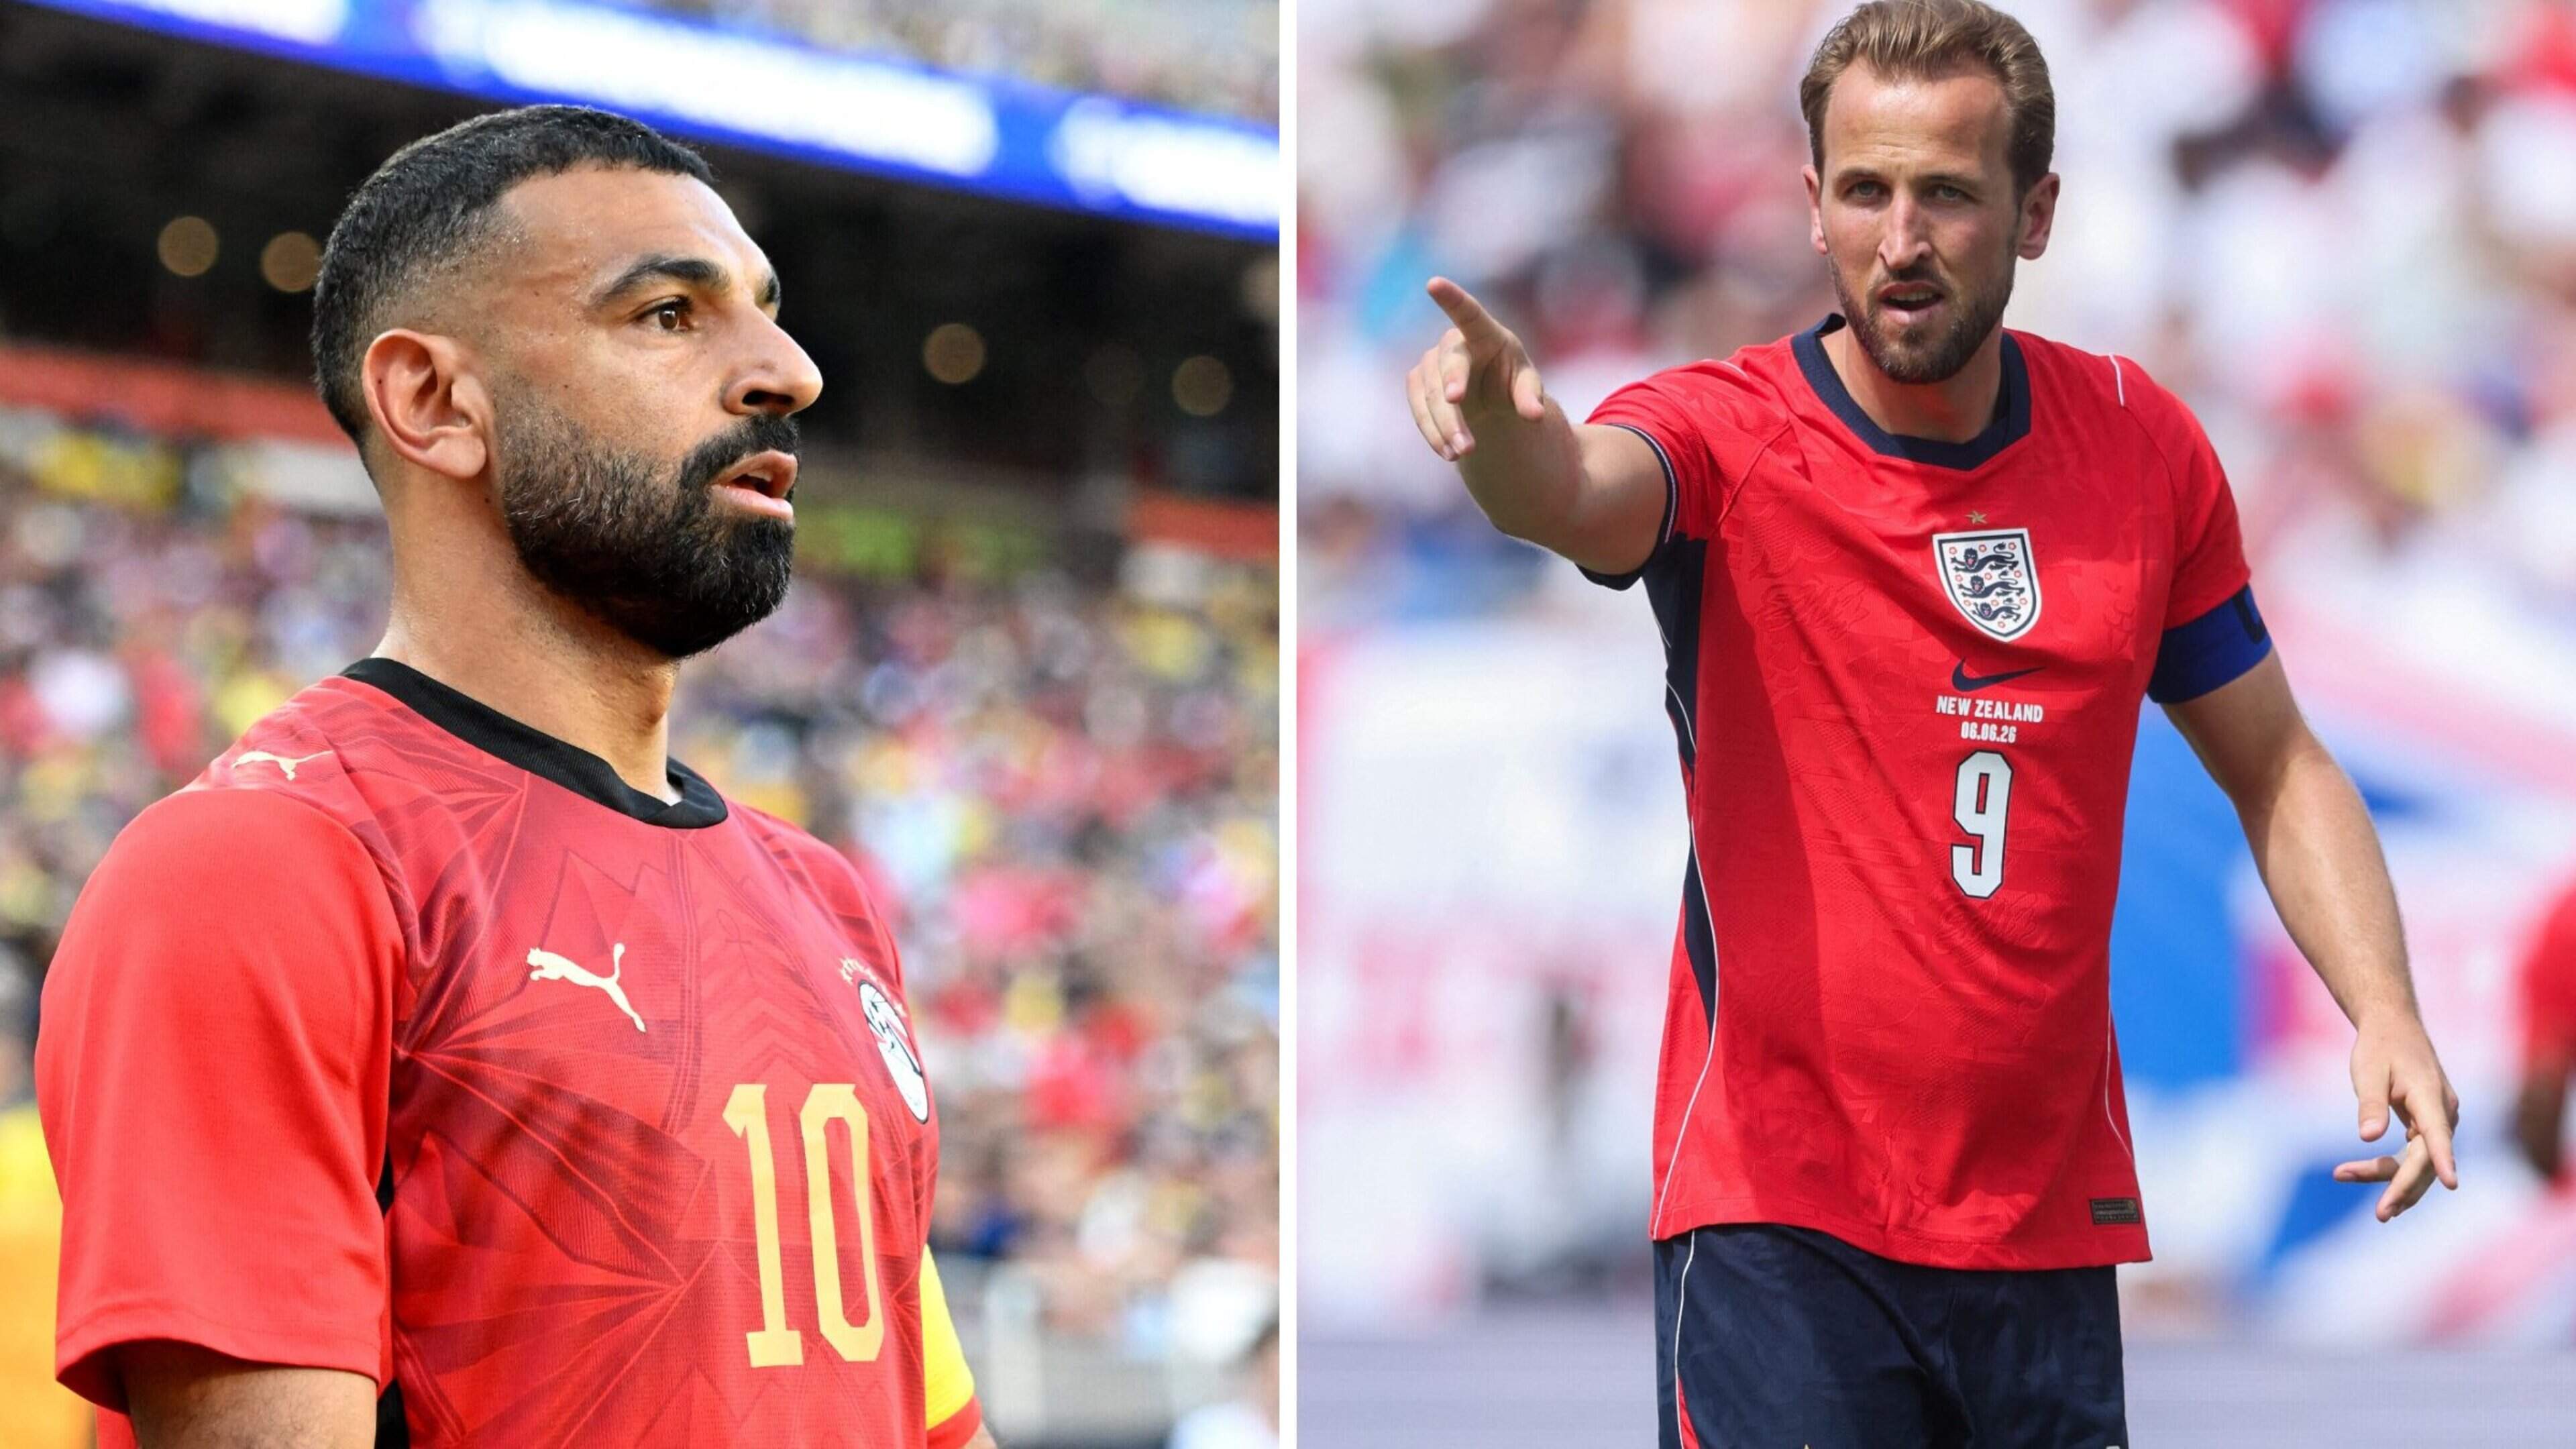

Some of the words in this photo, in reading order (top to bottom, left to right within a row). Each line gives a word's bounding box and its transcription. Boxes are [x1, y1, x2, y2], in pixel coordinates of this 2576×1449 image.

[1936, 695, 1972, 716] NEW
[1974, 699, 2043, 722] ZEALAND
[1960, 721, 2017, 743] 06.06.26
[1950, 749, 2012, 900] 9
[722, 1083, 885, 1368] 10
